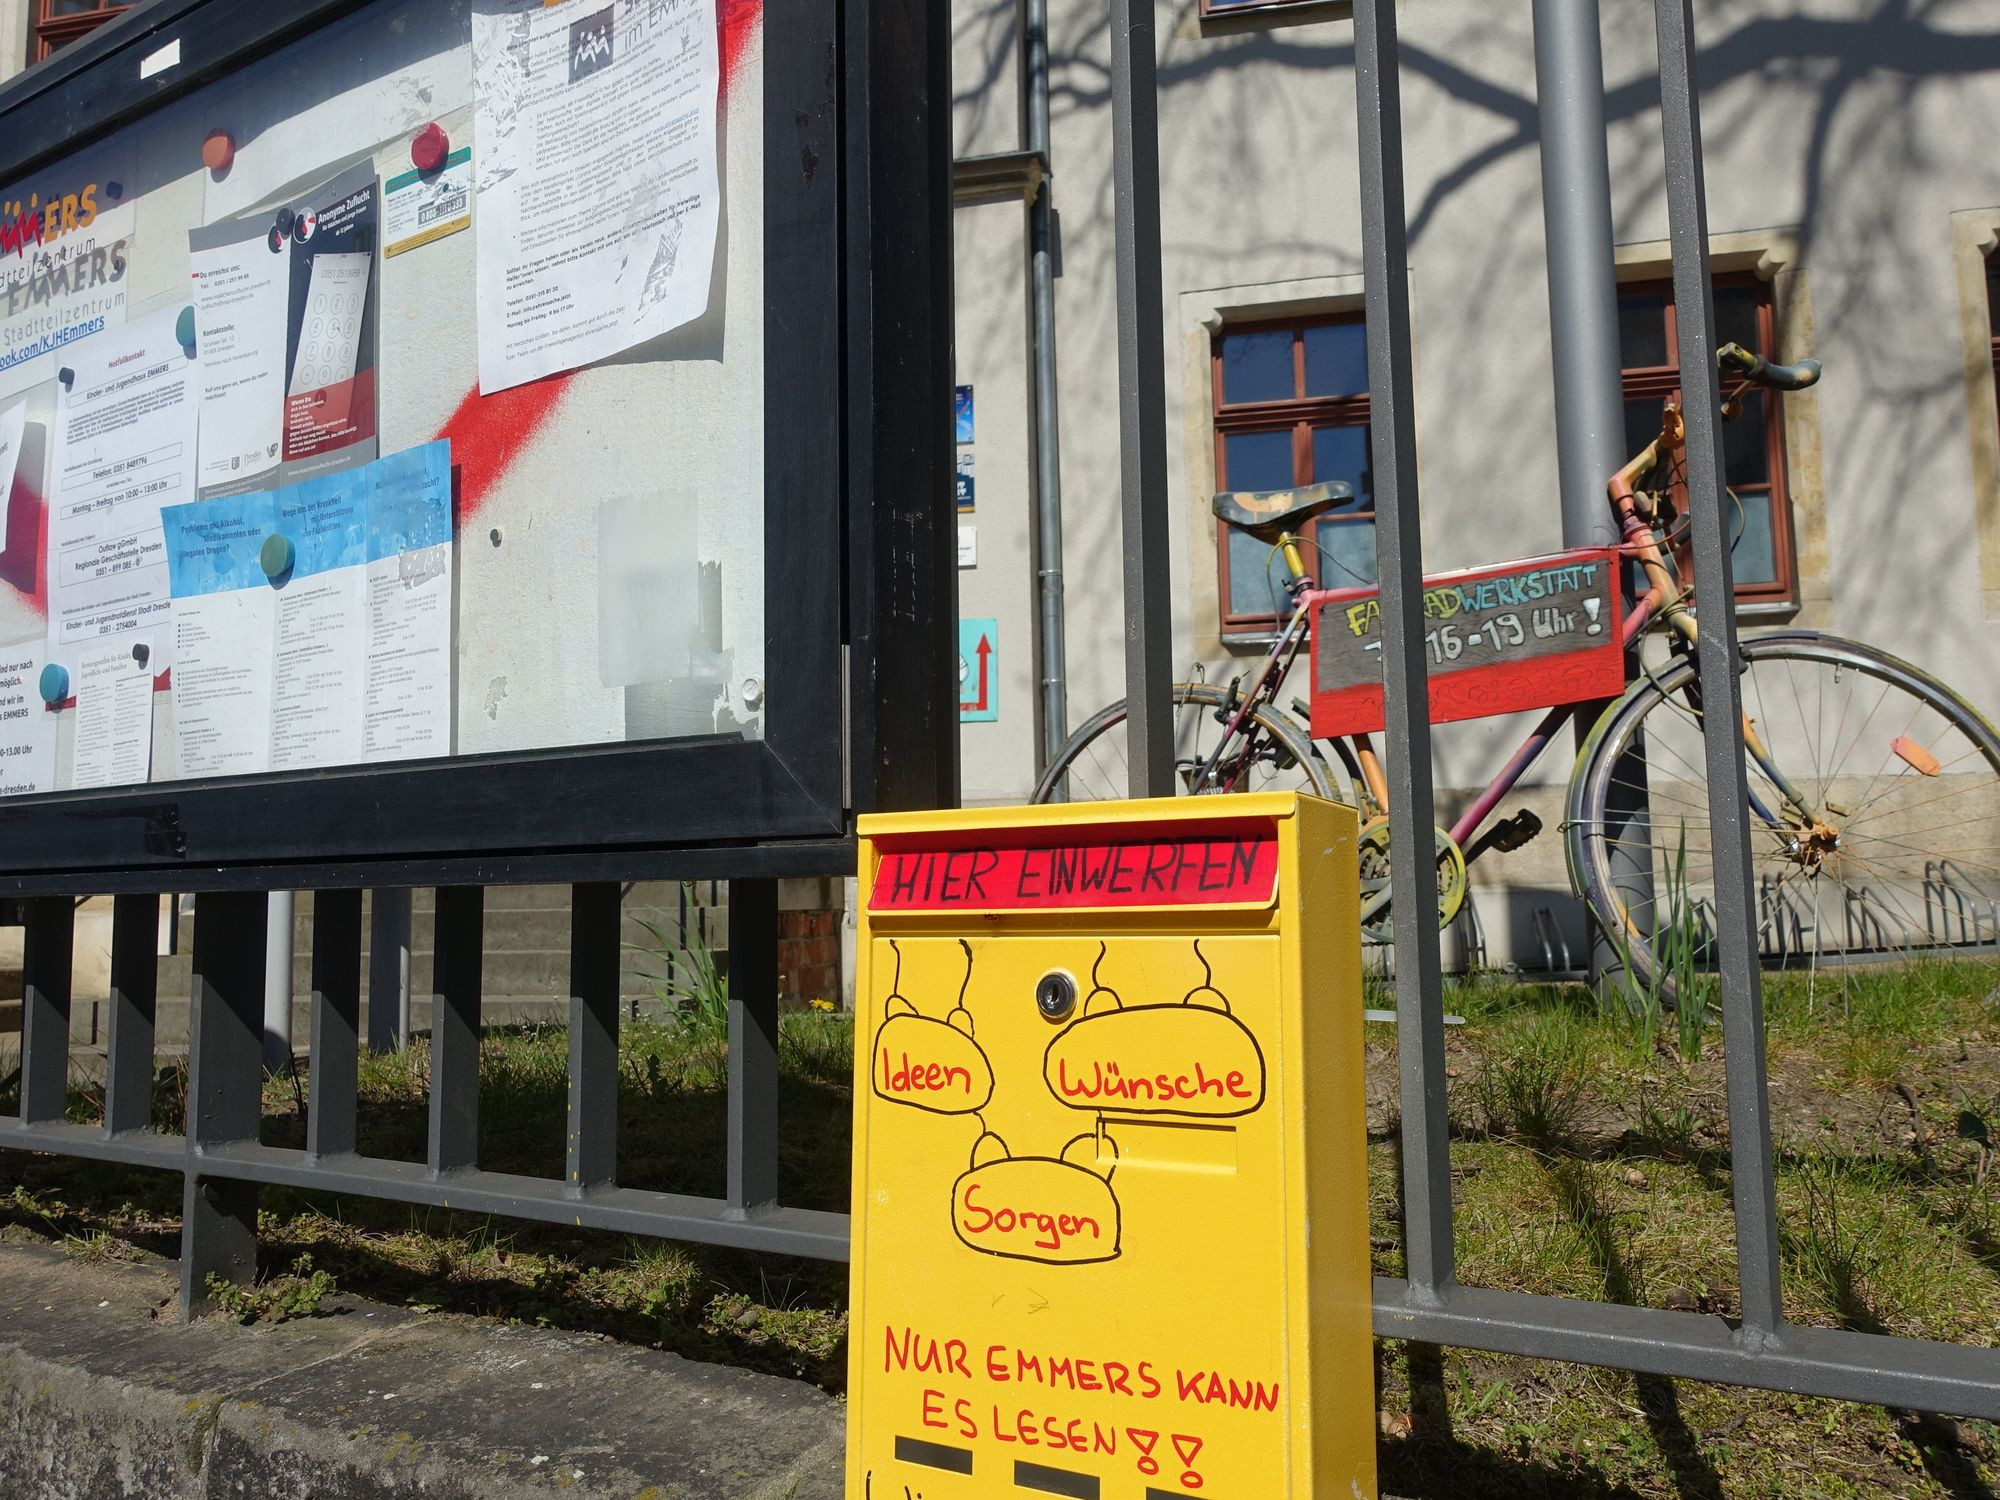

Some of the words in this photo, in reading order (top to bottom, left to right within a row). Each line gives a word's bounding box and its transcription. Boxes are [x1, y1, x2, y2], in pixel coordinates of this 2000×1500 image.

[318, 205, 346, 224] Anonyme
[346, 190, 370, 211] Zuflucht
[4, 292, 125, 346] Stadtteilzentrum
[105, 383, 115, 393] und
[115, 373, 146, 391] Jugendhaus
[147, 364, 169, 378] EMMERS
[72, 503, 92, 515] Montag
[96, 496, 113, 509] Freitag
[114, 494, 124, 502] von
[125, 488, 139, 499] 10:00
[144, 483, 158, 493] 13:00
[159, 480, 168, 489] Uhr
[75, 557, 100, 572] Regionale
[140, 541, 162, 554] Dresden
[99, 542, 116, 554] Outlaw
[117, 536, 138, 550] gGmbH
[96, 567, 107, 577] 0351
[85, 617, 94, 626] und
[95, 607, 137, 625] Jugendnotdienst
[138, 605, 152, 614] Stadt
[153, 601, 171, 612] Dresde
[1345, 564, 1598, 636] FAADWERKSTATT
[100, 625, 111, 635] 0351
[9, 664, 19, 672] nur
[20, 659, 33, 670] nach
[4, 708, 29, 720] EMMERS
[7, 695, 16, 704] wir
[17, 694, 24, 703] im
[22, 744, 32, 754] Uhr
[890, 847, 998, 903] HIER
[1017, 834, 1263, 899] EINWERFEN
[883, 1047, 971, 1095] Ideen
[1059, 1057, 1252, 1099] Wünsche
[963, 1184, 1100, 1249] Sorgen
[884, 1325, 972, 1378] NUR
[986, 1345, 1161, 1398] EMMERS
[1176, 1369, 1279, 1413] KANN
[922, 1389, 978, 1439] ES
